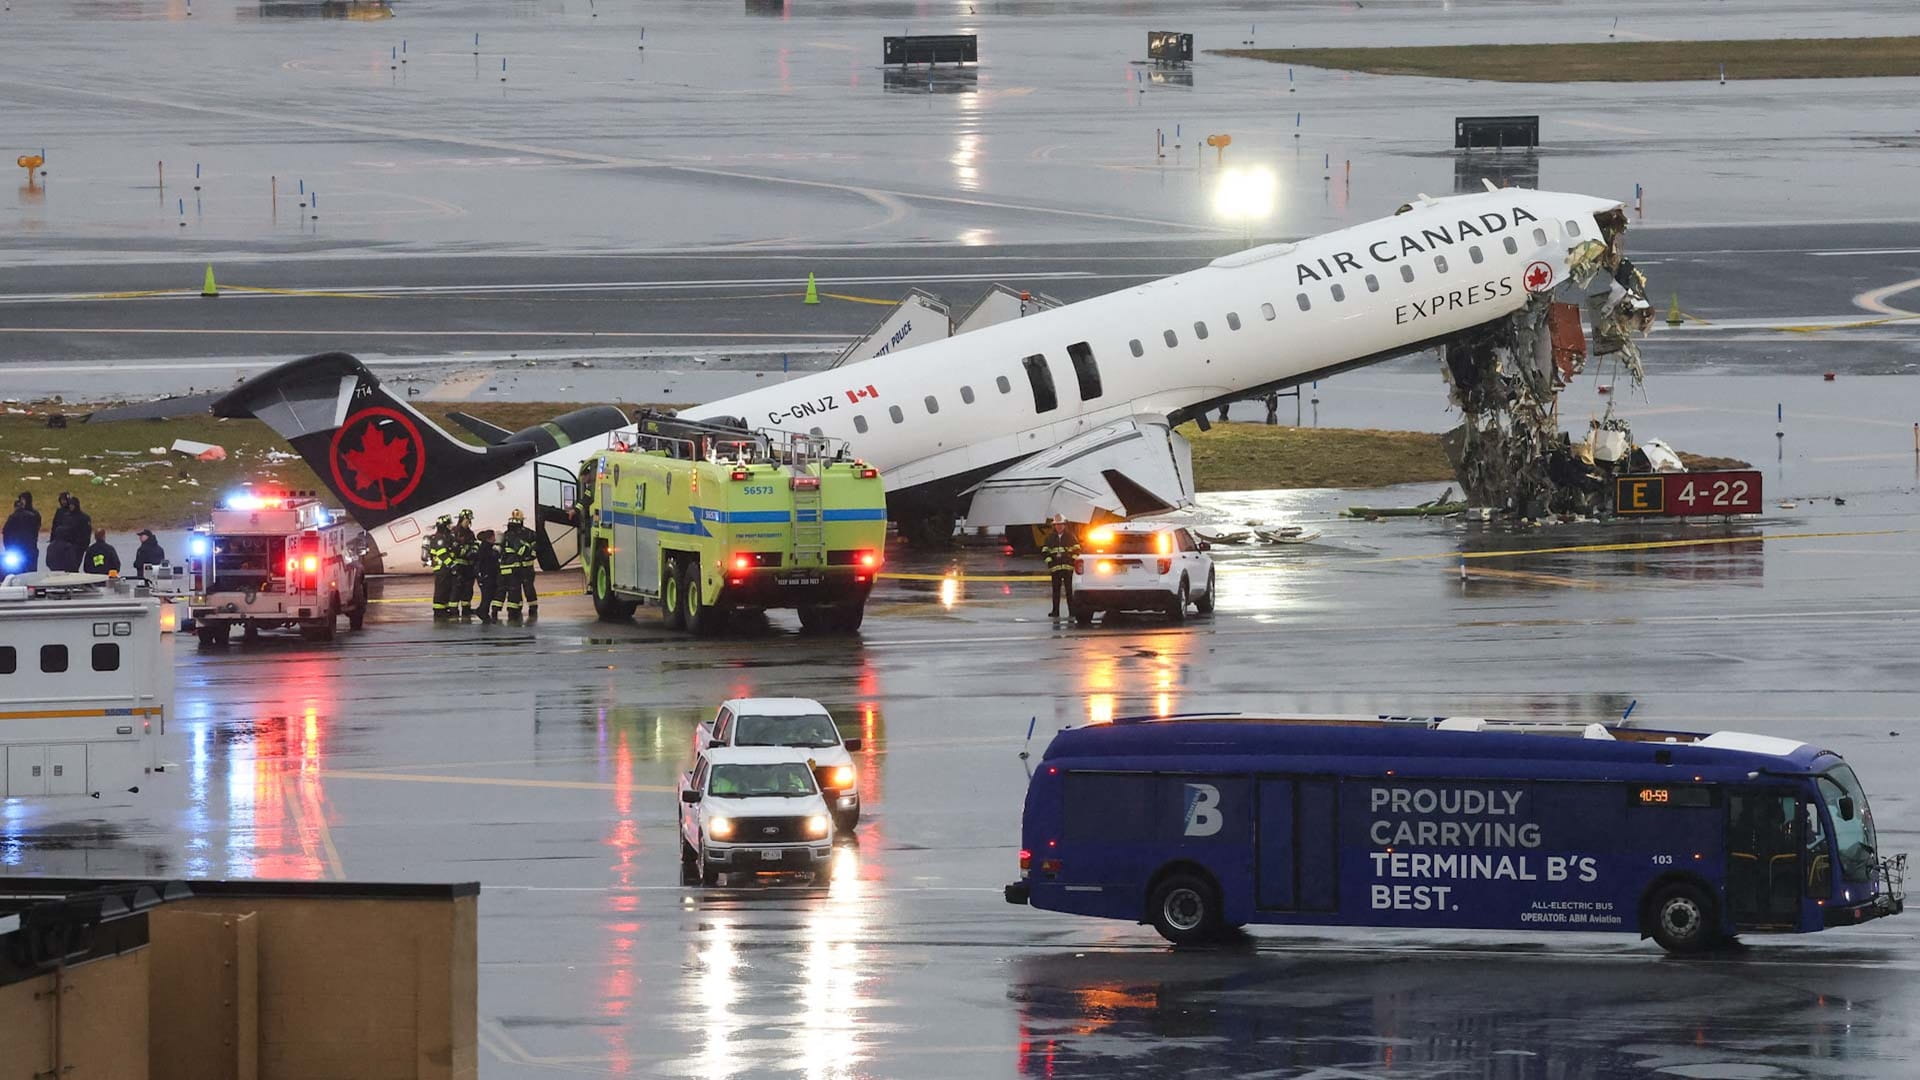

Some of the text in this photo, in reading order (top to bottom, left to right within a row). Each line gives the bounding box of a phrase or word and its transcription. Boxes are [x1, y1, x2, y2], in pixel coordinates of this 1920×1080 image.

[1296, 207, 1538, 285] AIR CANADA
[1395, 276, 1513, 325] EXPRESS
[891, 319, 912, 348] POLICE
[768, 395, 839, 425] C-GNJZ
[743, 486, 774, 495] 56573
[1633, 480, 1749, 508] E 4-22
[1371, 788, 1523, 815] PROUDLY
[1370, 820, 1541, 848] CARRYING
[1370, 853, 1598, 882] TERMINAL B'S
[1652, 855, 1673, 865] 103
[1371, 885, 1459, 911] BEST.
[1531, 902, 1614, 910] ALL-ELECTRIC BUS
[1520, 912, 1622, 924] OPERATOR: ABM Aviation
